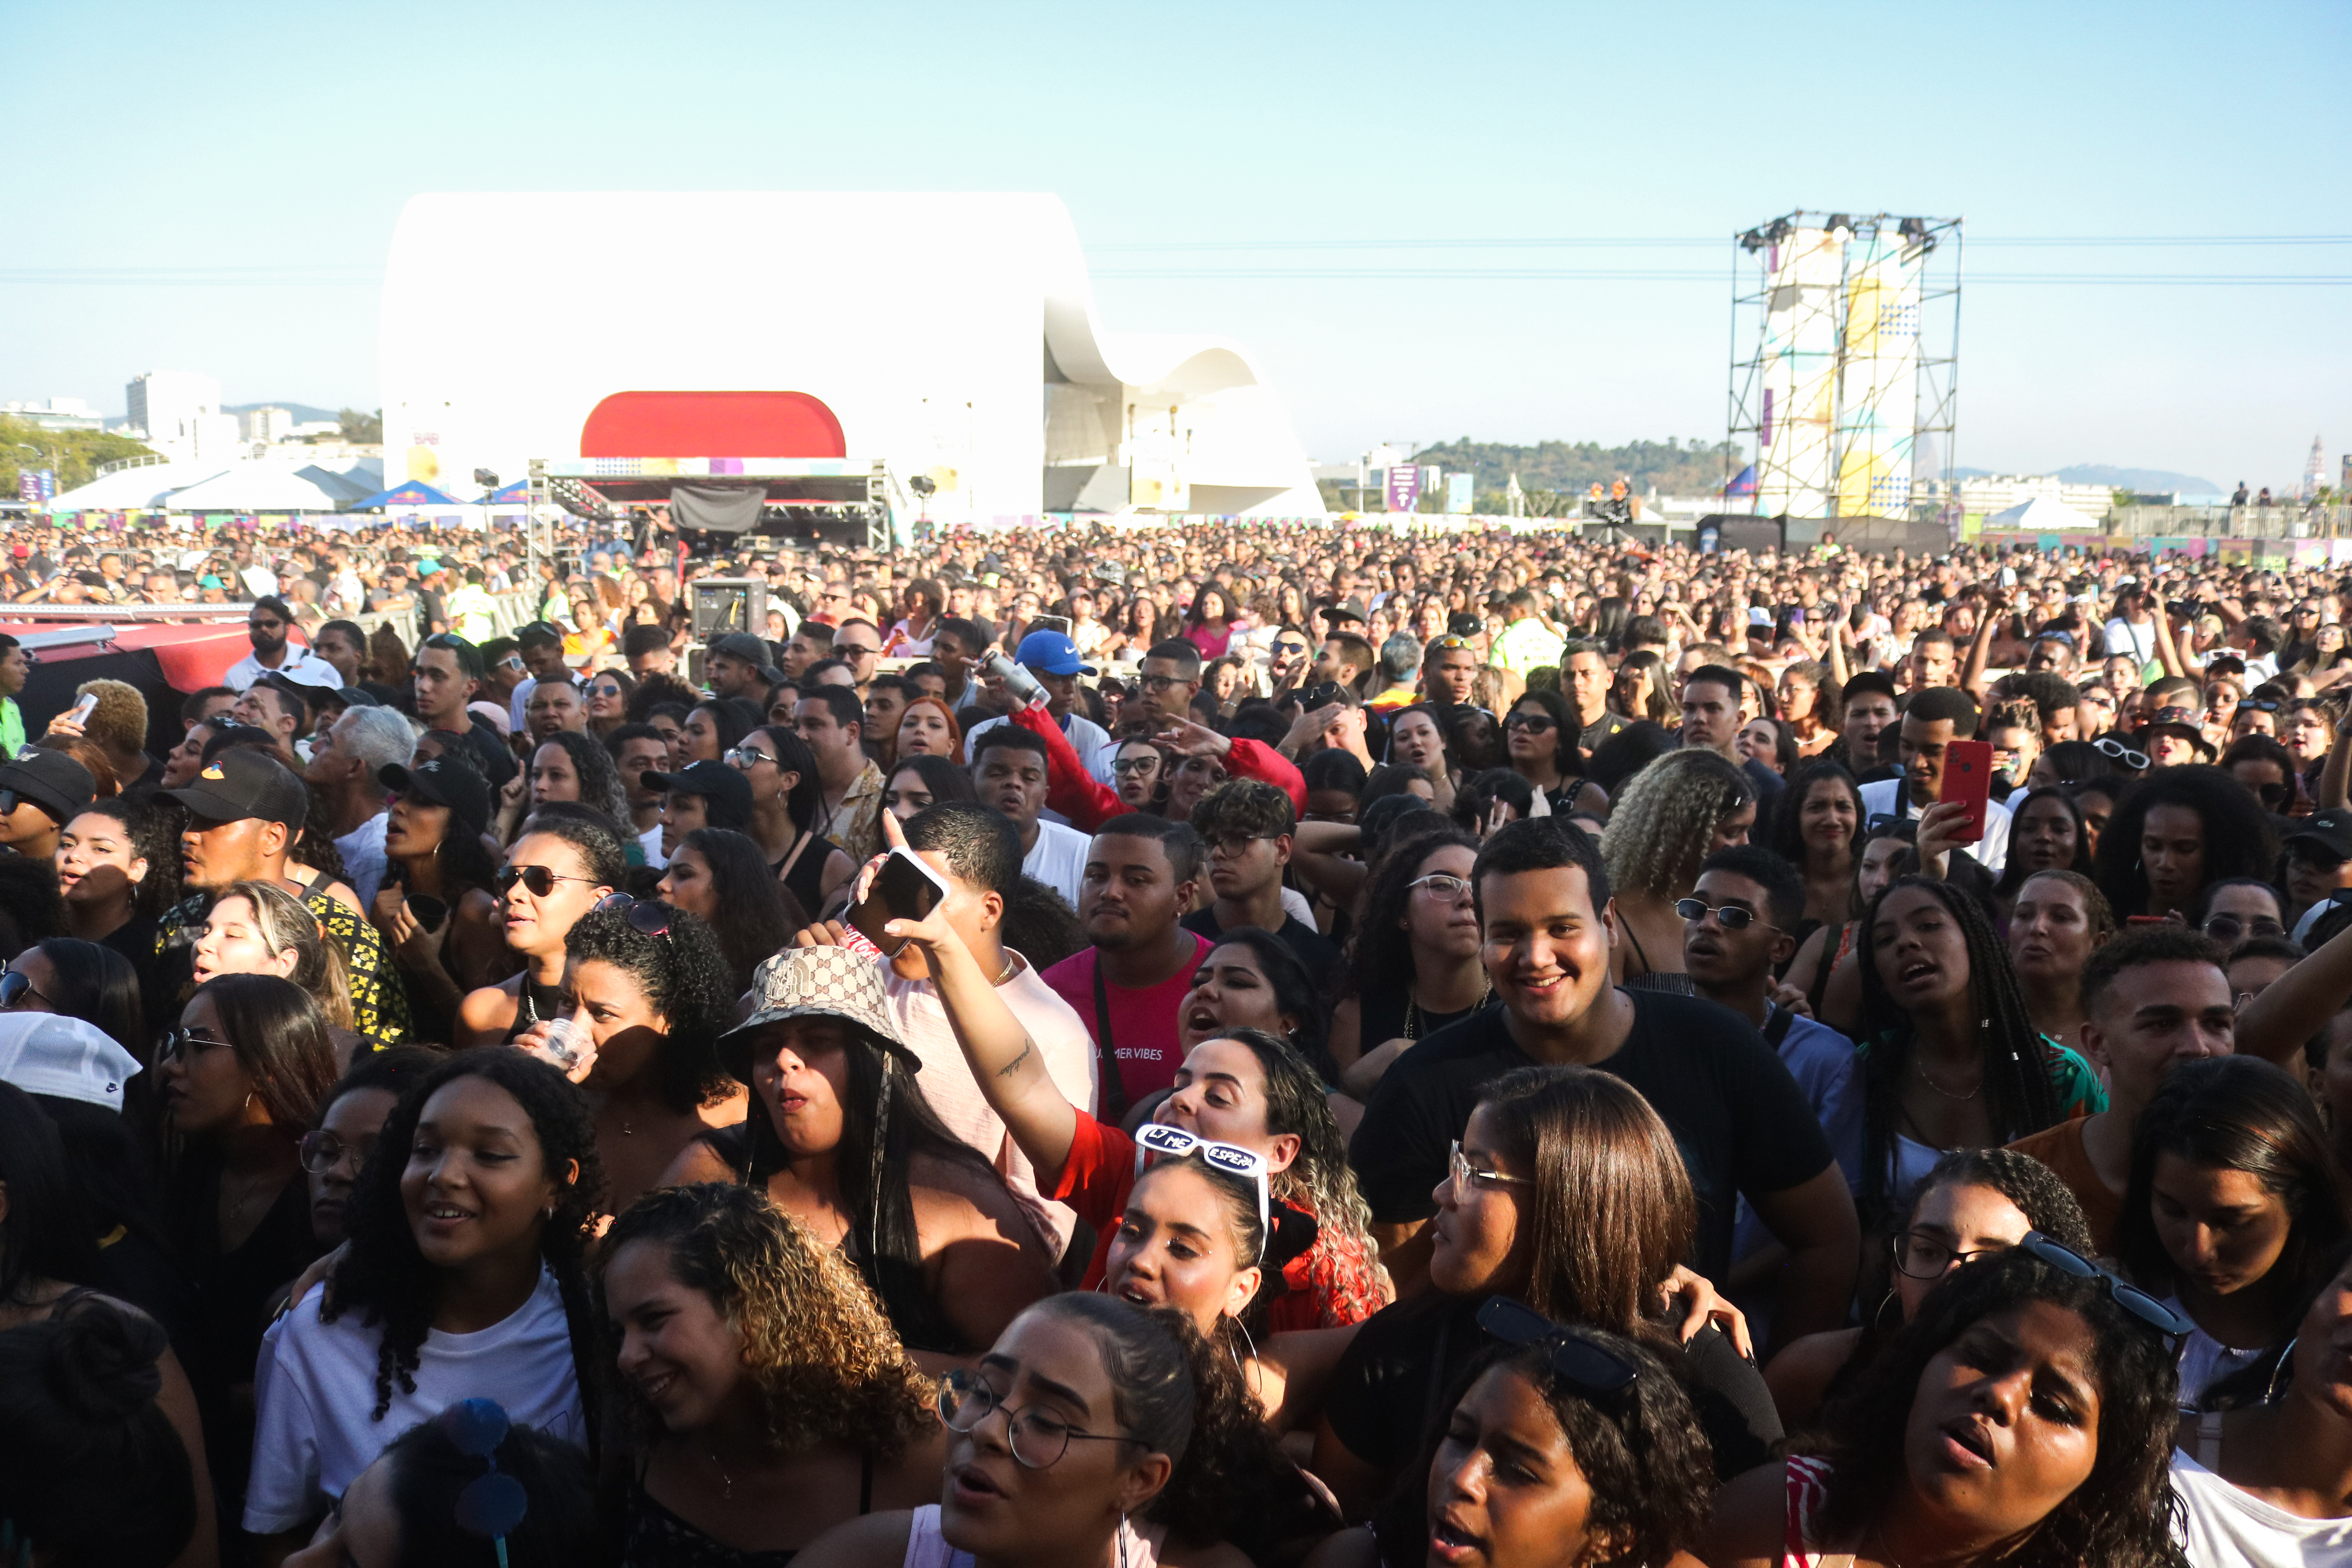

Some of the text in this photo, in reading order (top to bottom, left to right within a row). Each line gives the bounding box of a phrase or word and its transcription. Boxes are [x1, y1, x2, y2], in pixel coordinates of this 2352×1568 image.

[764, 984, 793, 1001] GUCCI
[1134, 1048, 1163, 1061] VIBES
[1149, 1129, 1253, 1168] L7 ME ESPERA
